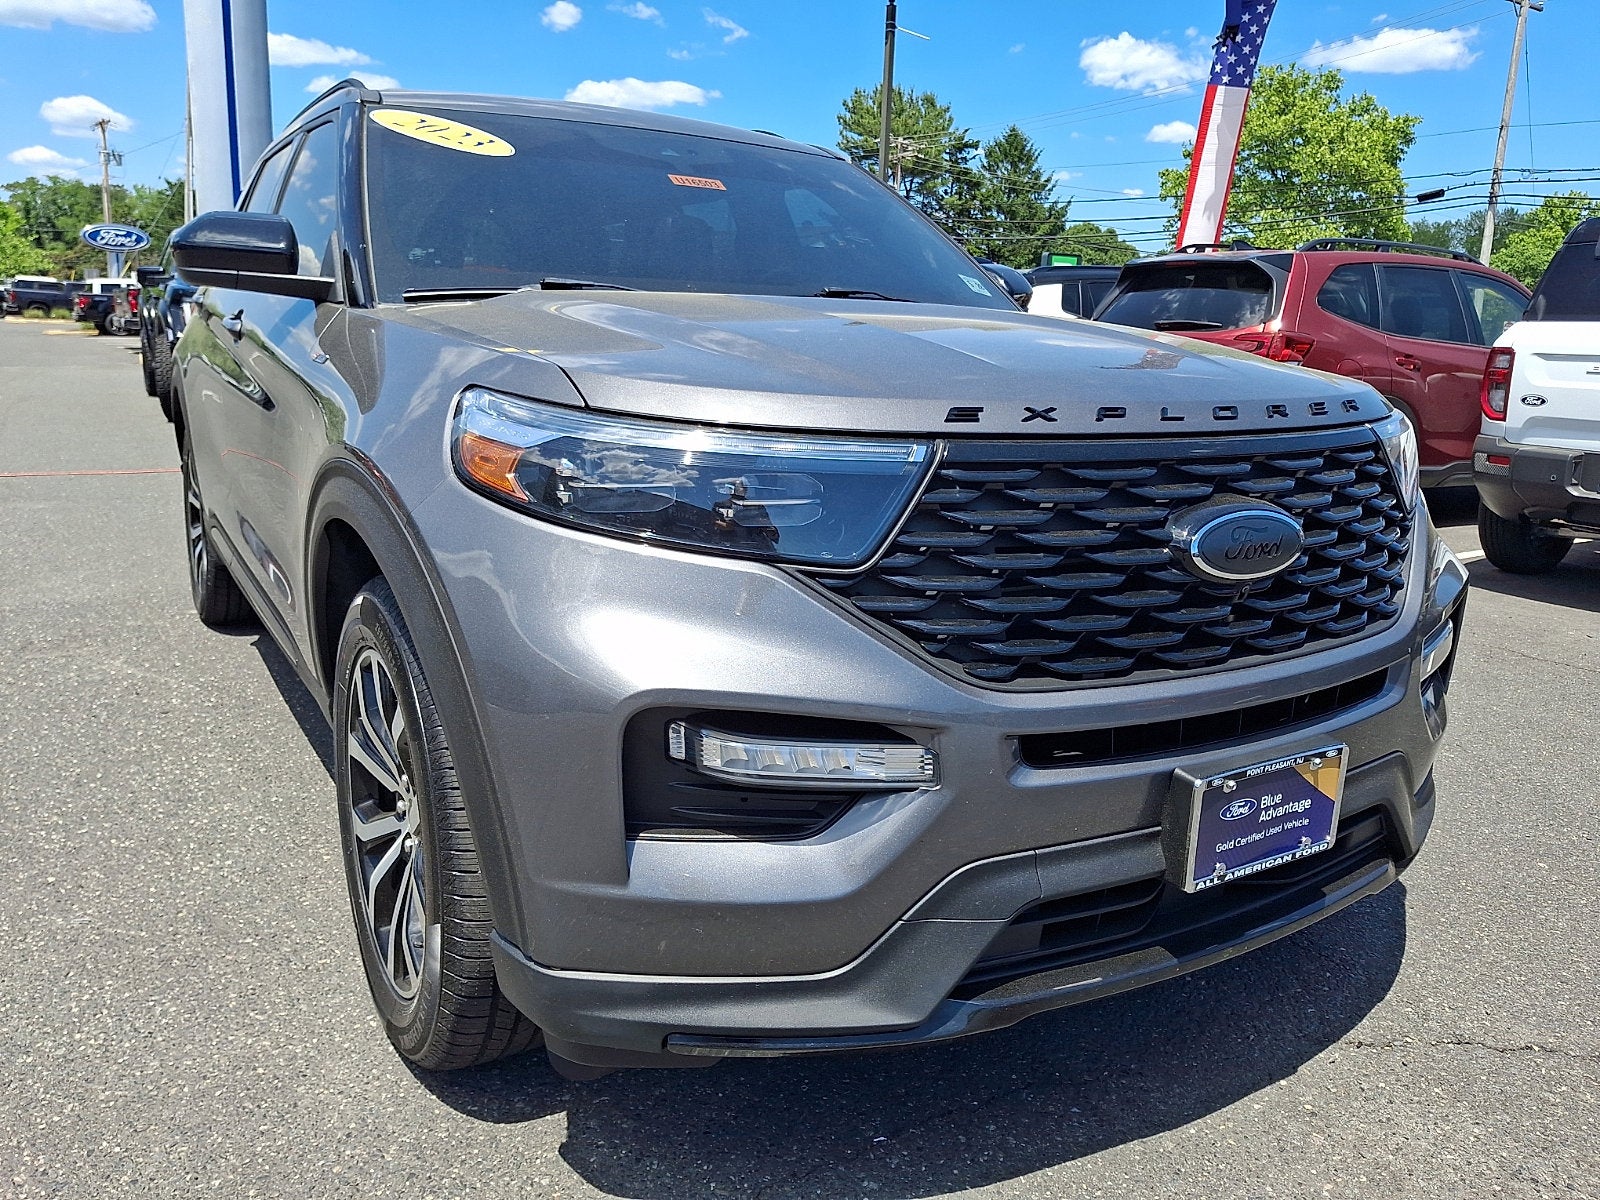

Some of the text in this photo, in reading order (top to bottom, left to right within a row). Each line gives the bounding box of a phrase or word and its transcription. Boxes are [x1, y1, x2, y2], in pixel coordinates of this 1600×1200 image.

[96, 229, 137, 247] Ford
[943, 399, 1361, 423] EXPLORER
[1224, 525, 1284, 561] Ford
[1296, 757, 1305, 765] NJ
[1226, 801, 1251, 818] Ford
[1258, 799, 1312, 823] Advantage
[1260, 793, 1283, 809] Blue
[1215, 817, 1310, 853] Gold Certified Used Vehicle
[1195, 842, 1330, 891] ALL AMERICAN FORD
